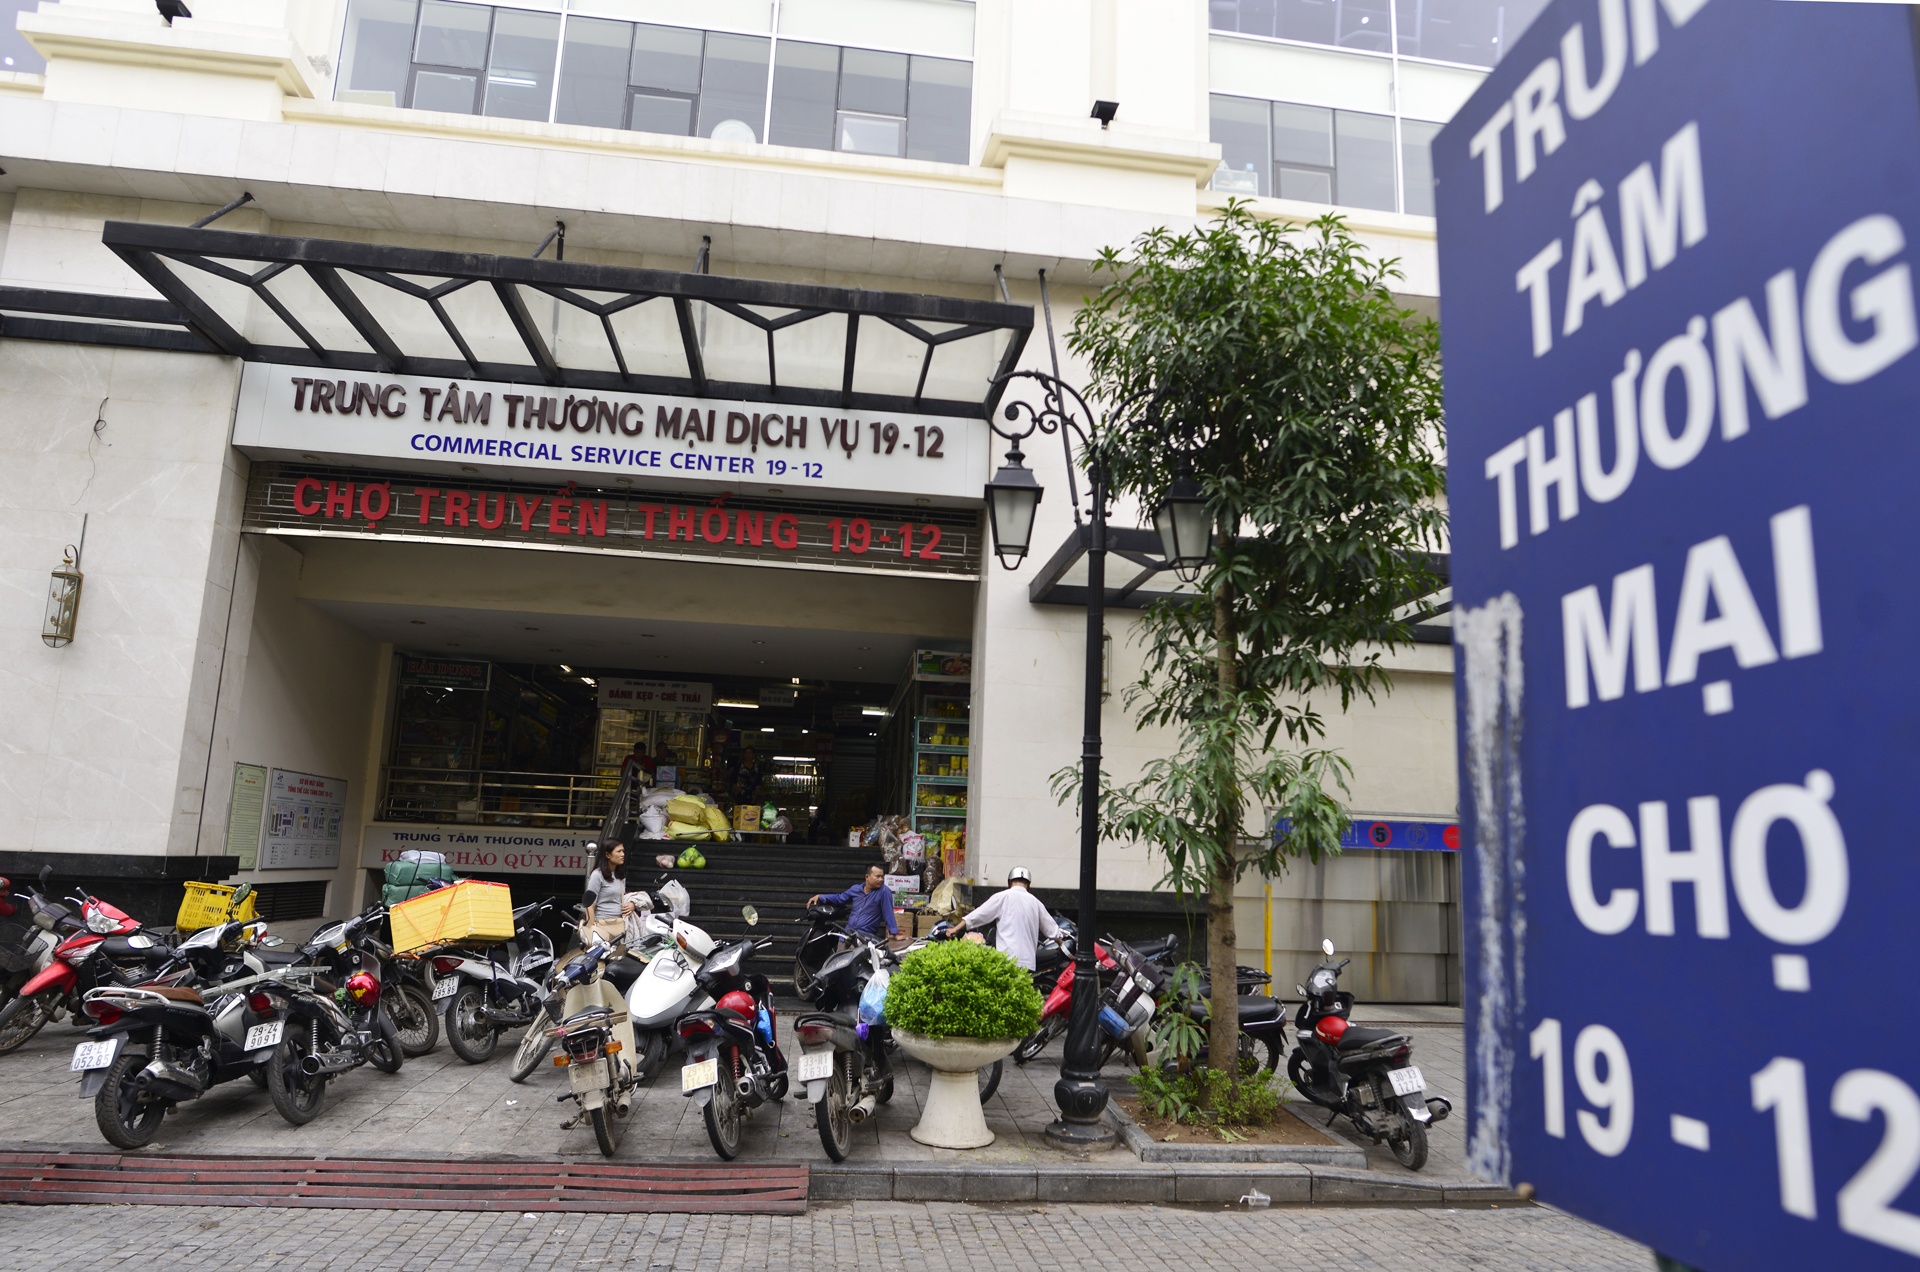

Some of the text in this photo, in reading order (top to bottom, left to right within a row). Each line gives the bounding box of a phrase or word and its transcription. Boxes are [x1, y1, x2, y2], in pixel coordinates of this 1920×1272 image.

[1516, 121, 1708, 358] TÂM
[1485, 214, 1919, 550] THƯƠNG
[291, 377, 407, 417] TRUNG
[419, 382, 492, 425] TÂM
[503, 393, 644, 436] THƯƠNG
[655, 405, 716, 448] MẠI
[726, 411, 808, 453] DỊCH
[820, 417, 860, 459] VỤ
[410, 433, 562, 461] COMMERCIAL
[571, 445, 662, 468] SERVICE
[669, 452, 755, 474] CENTER
[293, 476, 392, 529] CHỢ
[414, 481, 608, 537] TRUYỀN
[638, 491, 799, 550] THỐNG
[1561, 503, 1824, 716] MẠI
[608, 688, 633, 699] BÁNH
[636, 691, 653, 702] KẸO
[682, 692, 701, 703] THÁI
[393, 832, 441, 843] TRUNG
[447, 832, 479, 844] TÂM
[484, 835, 544, 847] THƯƠNG
[548, 838, 576, 849] MẠI
[1375, 827, 1386, 843] 5
[444, 848, 497, 866] CHÀO
[504, 849, 548, 869] QÚY
[1565, 769, 1850, 991] CHỢ
[252, 1023, 278, 1038] 29-Z4
[250, 1033, 276, 1048] 9091
[74, 1054, 110, 1069] 052.85
[804, 1054, 828, 1067] 33-R1
[803, 1065, 828, 1079] 2630
[1398, 1079, 1422, 1093] 1274
